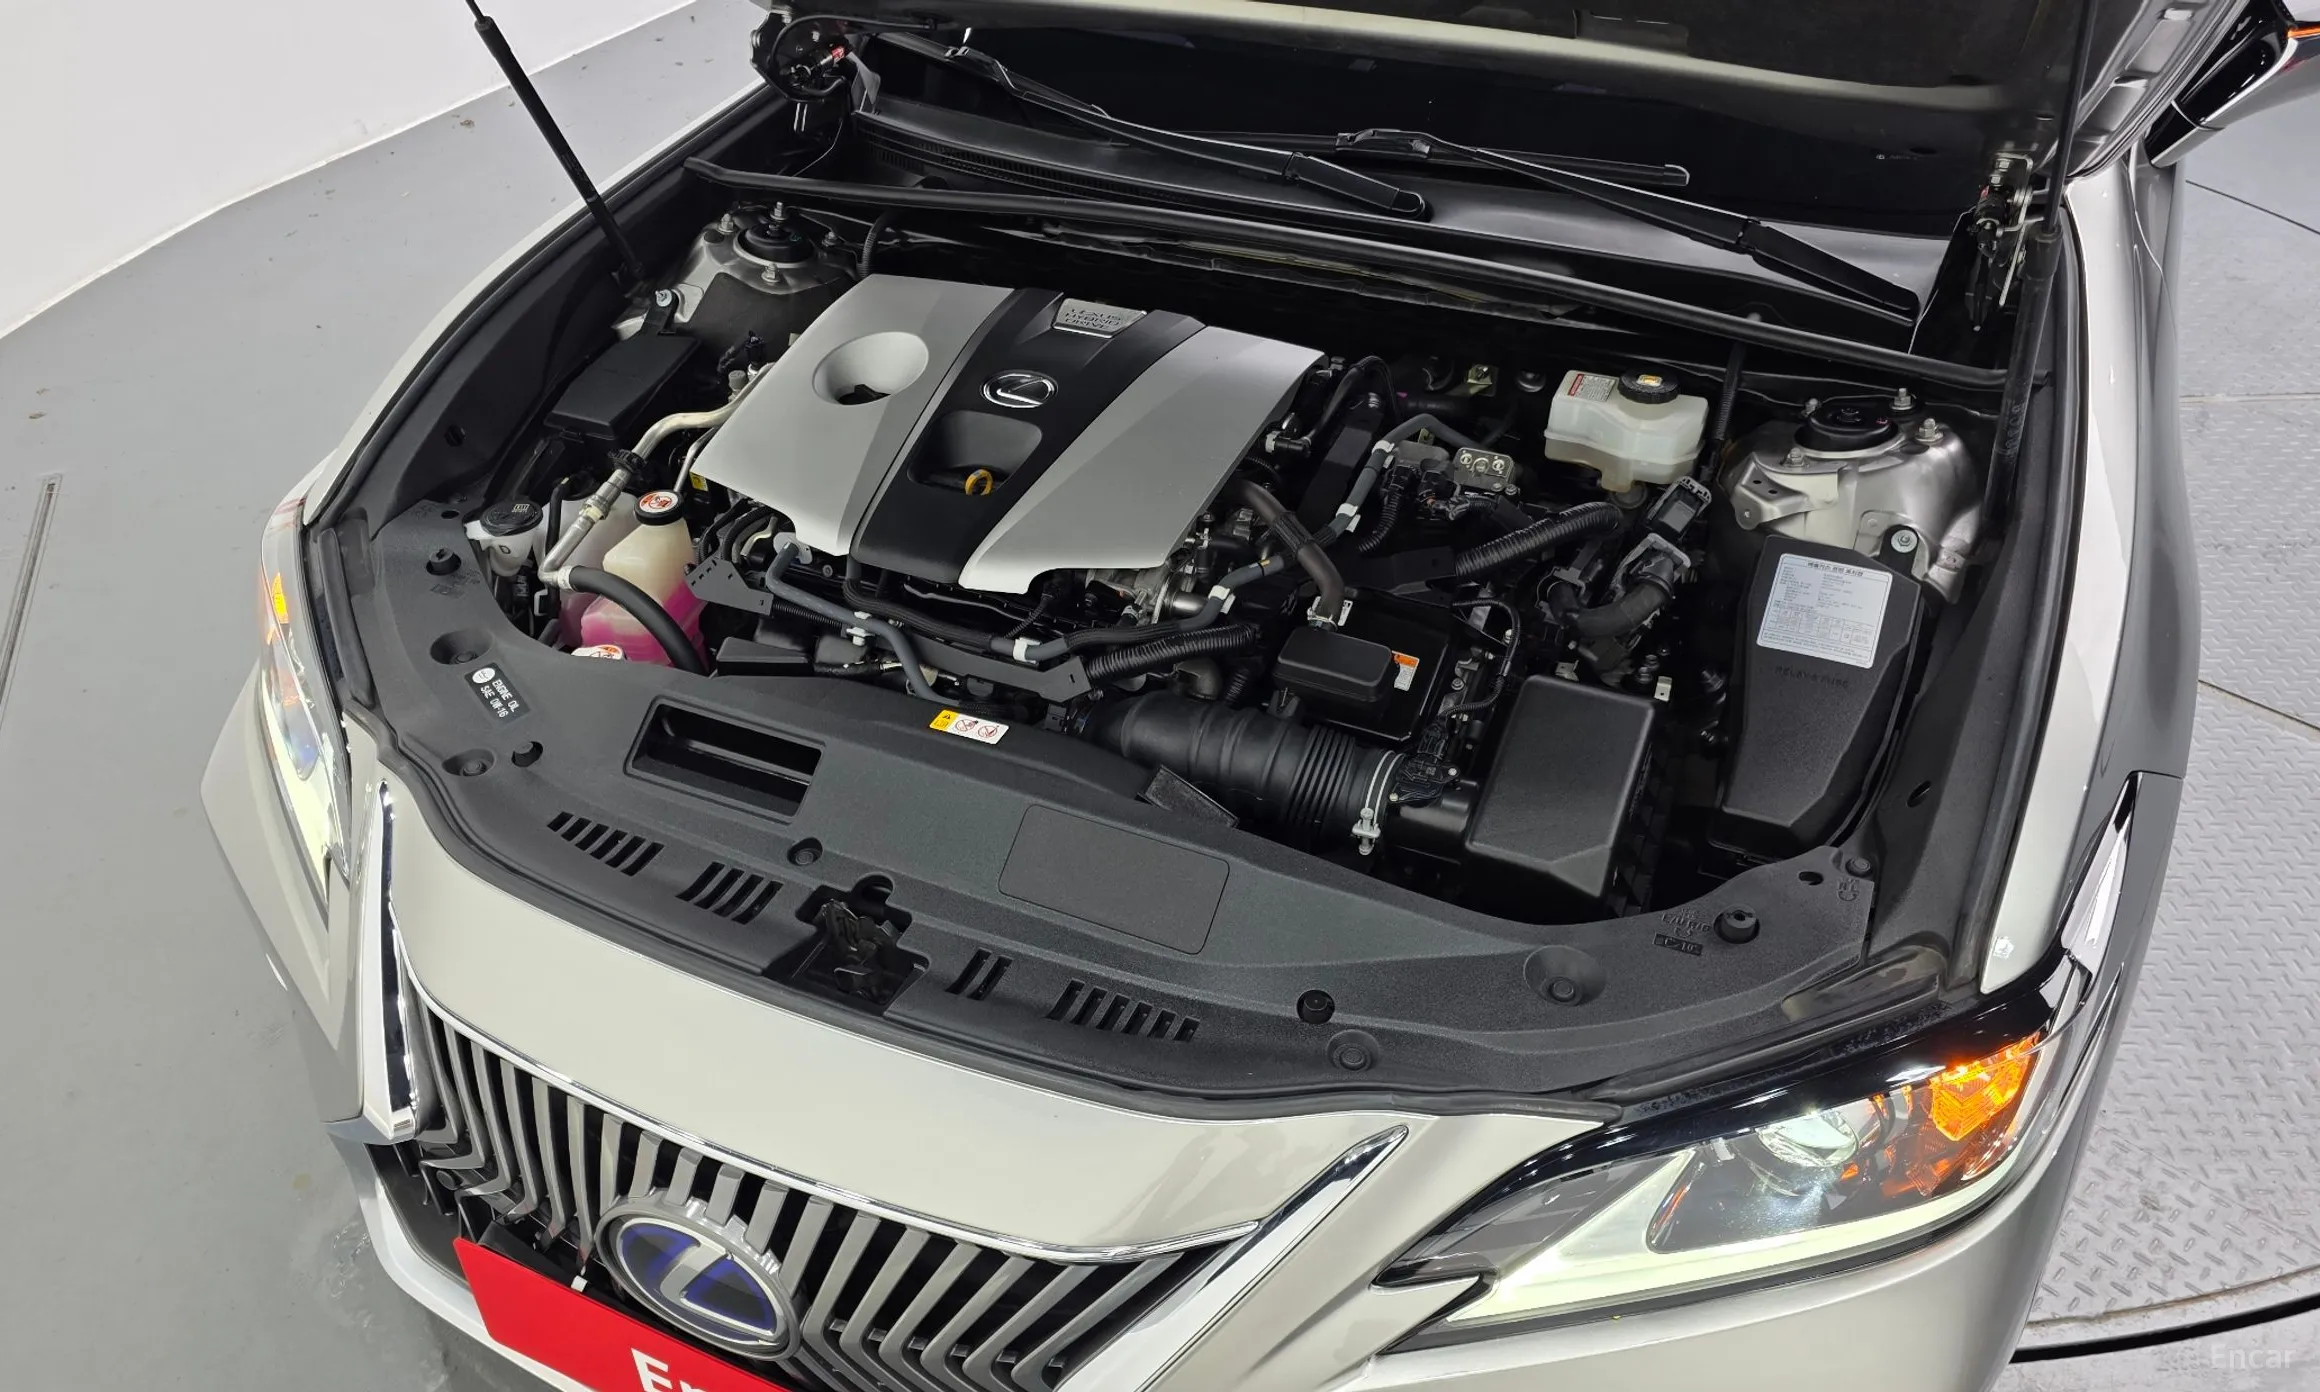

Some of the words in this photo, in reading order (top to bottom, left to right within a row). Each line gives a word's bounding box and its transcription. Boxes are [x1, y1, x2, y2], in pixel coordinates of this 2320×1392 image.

[480, 685, 496, 699] SAE
[489, 698, 509, 718] 0W-16
[491, 678, 513, 701] ENGINE
[507, 700, 520, 713] OIL
